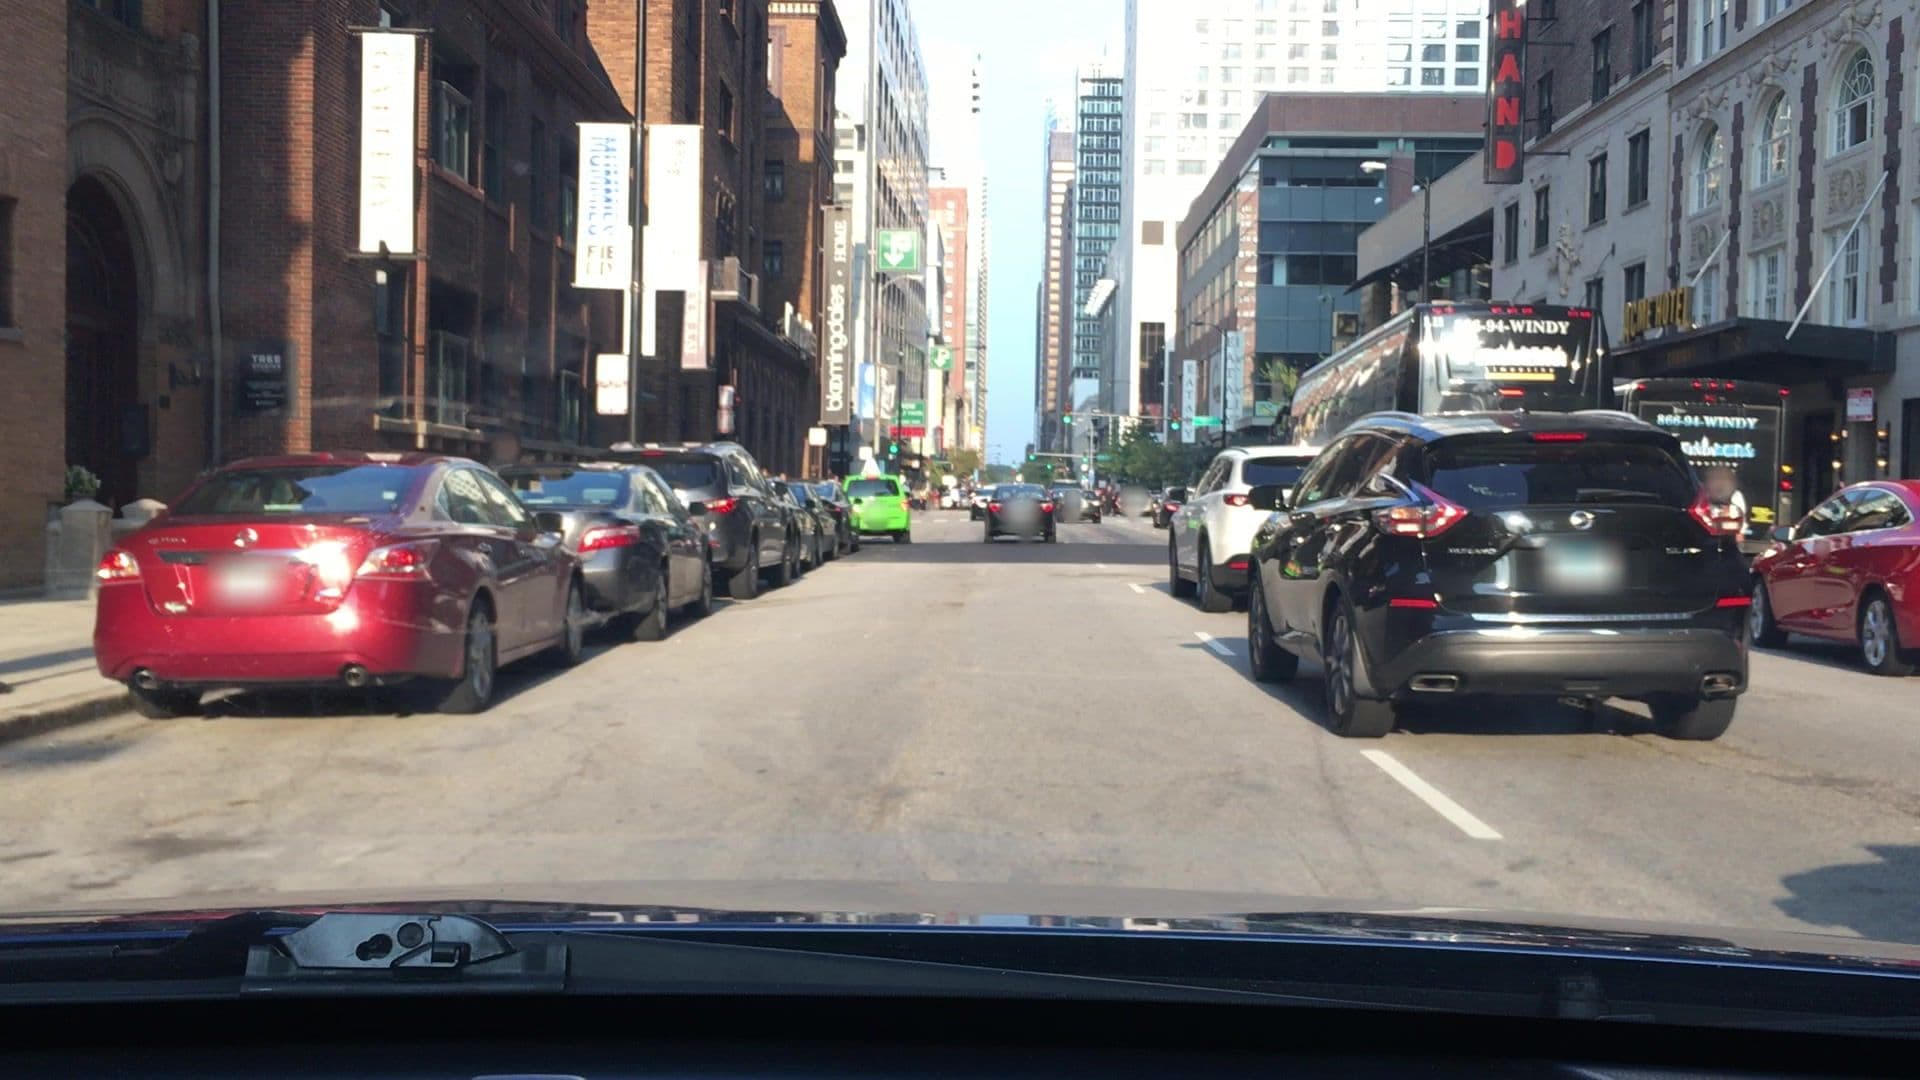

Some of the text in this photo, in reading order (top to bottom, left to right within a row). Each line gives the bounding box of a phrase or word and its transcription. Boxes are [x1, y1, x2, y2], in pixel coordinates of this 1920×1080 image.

[1496, 10, 1521, 169] HAND
[1656, 287, 1690, 330] HOTEL
[1184, 363, 1194, 439] EATAY
